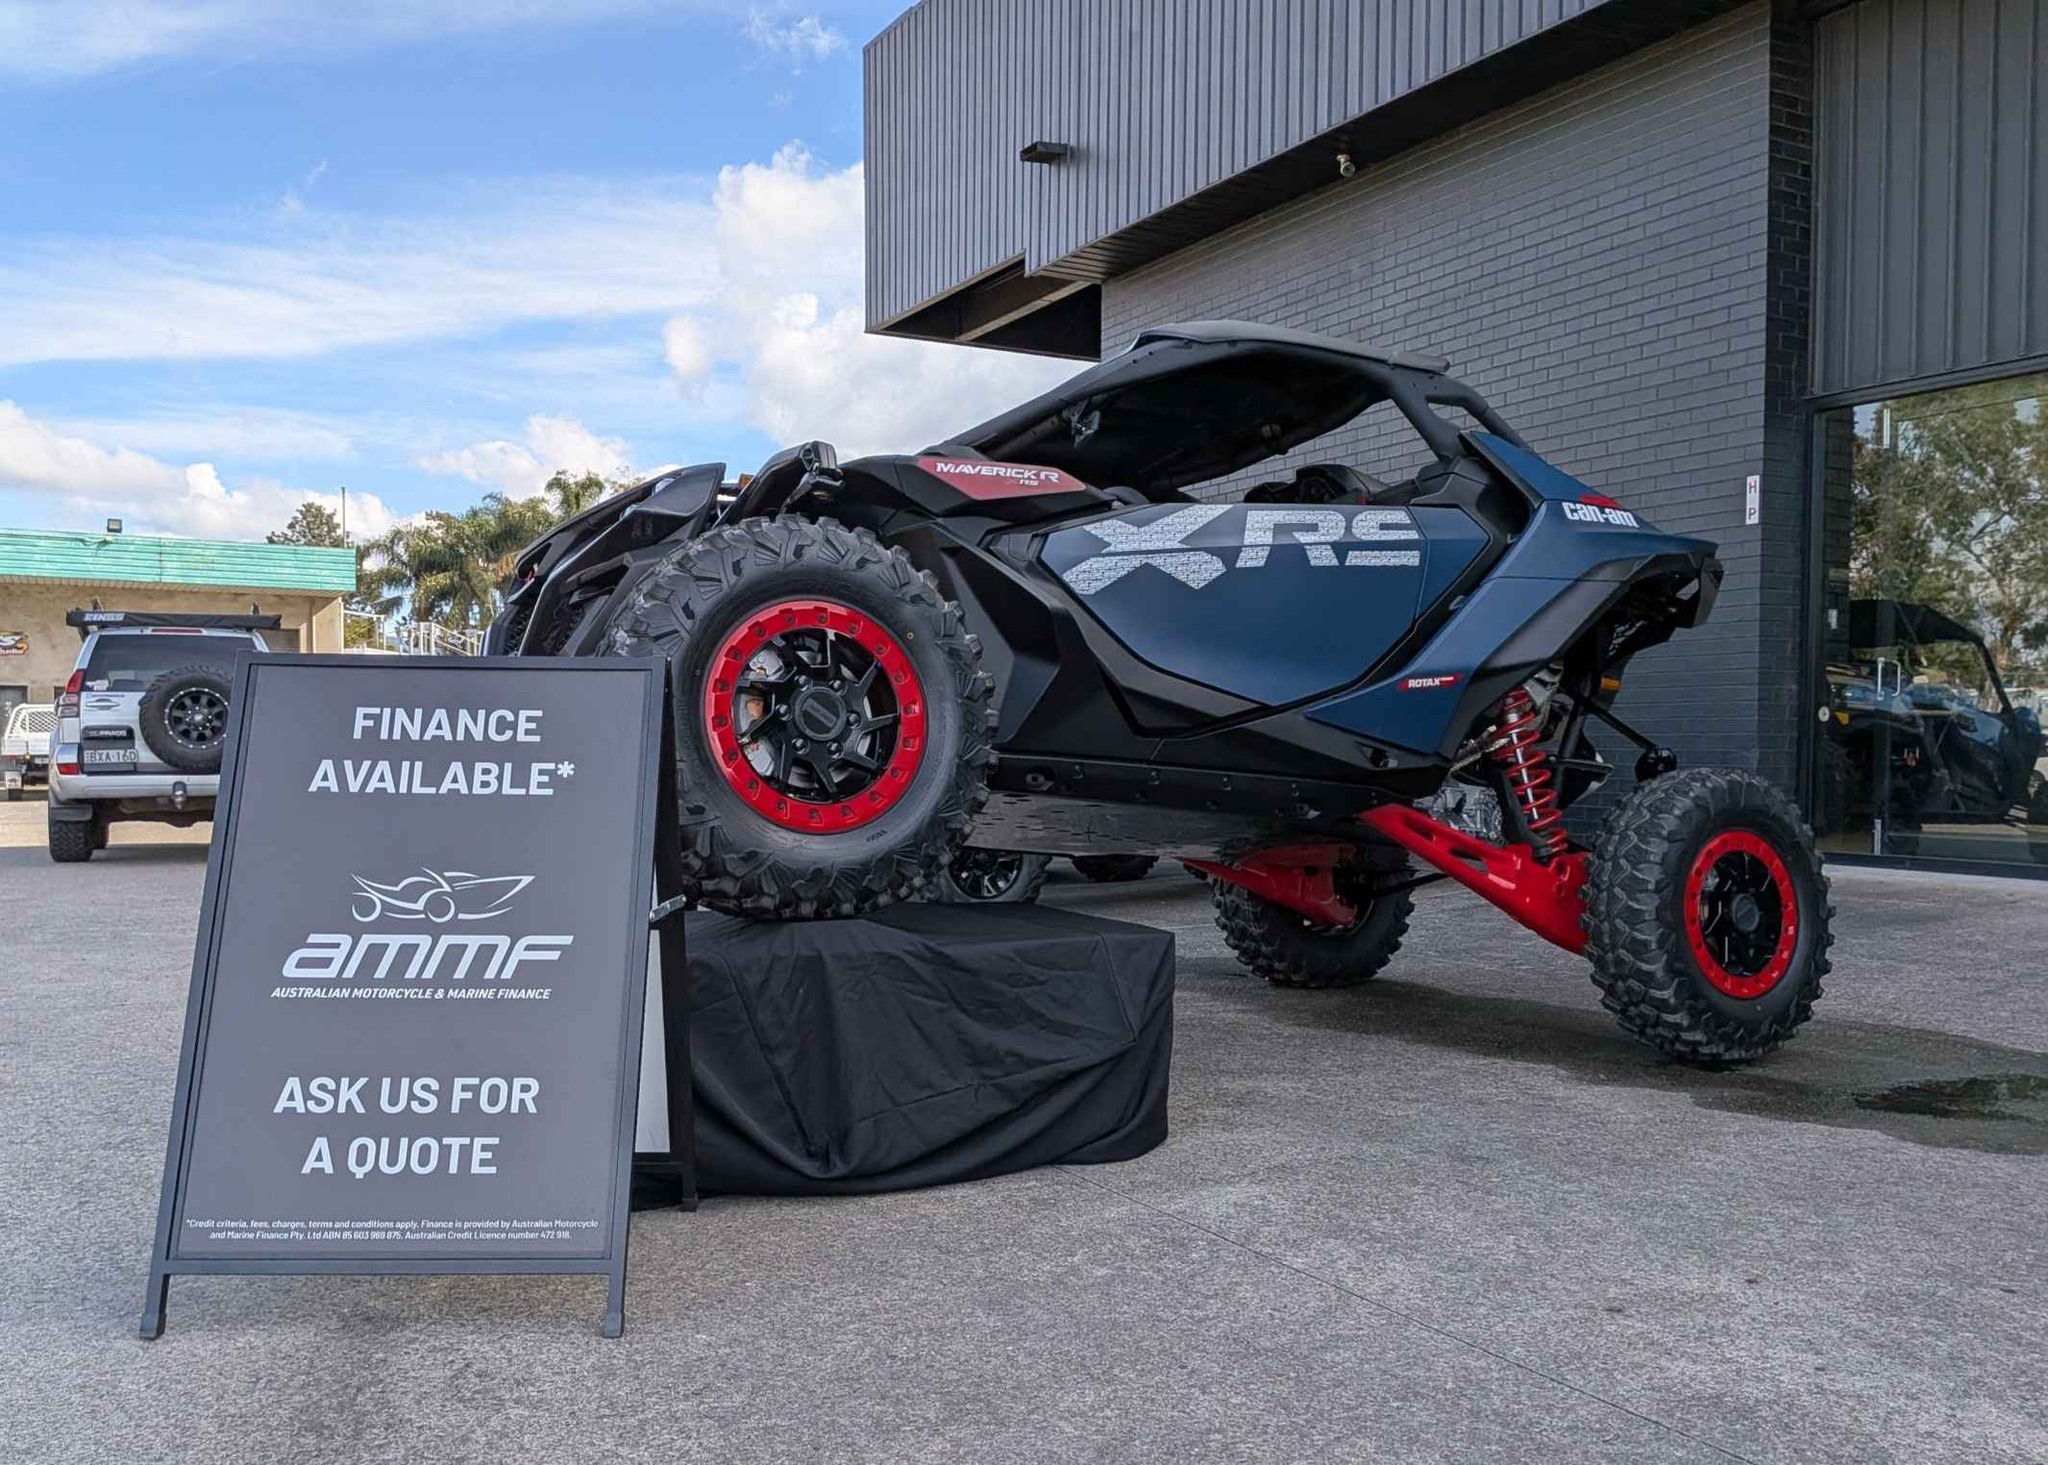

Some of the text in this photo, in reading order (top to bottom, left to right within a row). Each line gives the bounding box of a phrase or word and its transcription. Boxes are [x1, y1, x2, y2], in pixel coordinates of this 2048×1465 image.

[936, 462, 1061, 484] MAVERICK R
[1562, 501, 1640, 528] can-am
[1408, 677, 1440, 689] ROTAX
[353, 706, 543, 742] FINANCE
[270, 987, 552, 1000] AUSTRALIAN MOTORCYCLE & MARINE FINANCE
[273, 1077, 540, 1114] ASK US FOR
[301, 1137, 500, 1179] A QUOTE
[211, 1230, 226, 1239] and
[227, 1230, 255, 1239] Marine
[256, 1230, 289, 1239] Finance
[308, 1230, 320, 1239] Ltd
[322, 1230, 341, 1239] ABN
[405, 1230, 446, 1239] Australian
[448, 1230, 472, 1239] Credit
[474, 1230, 506, 1239] Licence
[508, 1230, 539, 1239] number
[309, 1219, 333, 1228] terms
[334, 1219, 349, 1228] and
[351, 1219, 394, 1228] conditions
[395, 1219, 419, 1230] apply.
[421, 1219, 453, 1228] Finance
[455, 1219, 462, 1228] is
[464, 1219, 499, 1230] provided
[501, 1219, 510, 1230] by
[512, 1219, 552, 1228] Australian
[554, 1219, 598, 1230] Motorcycle
